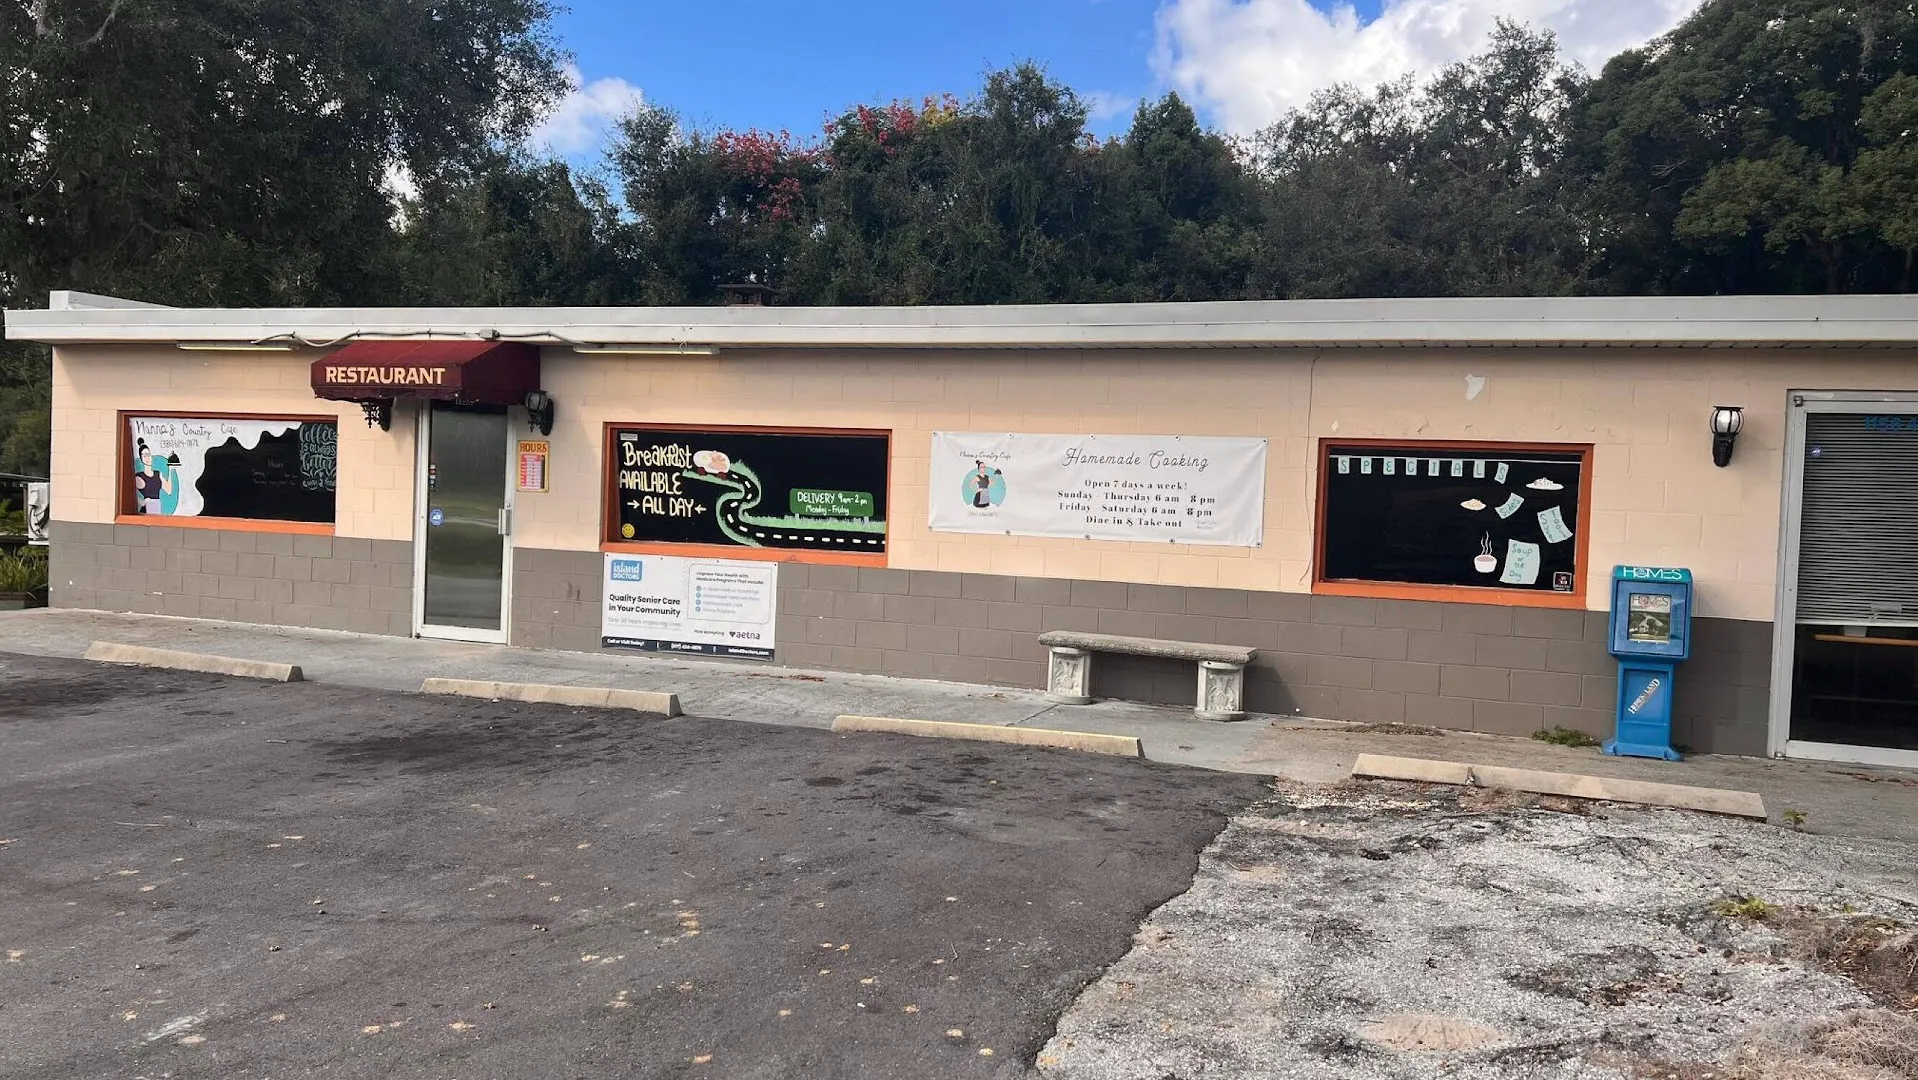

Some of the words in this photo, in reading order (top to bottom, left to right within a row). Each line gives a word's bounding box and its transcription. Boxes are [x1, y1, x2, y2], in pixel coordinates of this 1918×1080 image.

[325, 366, 446, 385] RESTAURANT
[182, 422, 213, 440] Country
[519, 442, 547, 453] HOURS
[622, 441, 693, 469] Breakfast
[1062, 447, 1141, 467] Homemade
[1149, 450, 1209, 473] Cooking
[1341, 458, 1506, 481] SPECIALS
[620, 470, 683, 495] AVAILABLE
[1084, 479, 1110, 490] Open
[1113, 480, 1120, 488] 7
[1122, 480, 1144, 491] days
[1157, 482, 1188, 491] week!
[797, 491, 836, 504] DELIVERY
[1057, 491, 1093, 500] Sunday
[1104, 492, 1151, 503] Thursday
[1155, 494, 1161, 502] 6
[1190, 494, 1197, 503] 8
[1200, 497, 1216, 505] pm
[642, 495, 666, 515] ALL
[669, 497, 695, 518] DAY
[805, 504, 827, 516] Monday
[832, 505, 850, 516] Friday
[1059, 503, 1091, 512] Friday
[1101, 504, 1148, 515] Saturday
[1151, 506, 1158, 514] 6
[1187, 507, 1194, 516] 8
[1196, 510, 1212, 518] pm
[1086, 515, 1109, 524] Dine
[1112, 516, 1123, 525] in
[1126, 519, 1134, 527] &
[1138, 518, 1162, 527] Take
[1165, 519, 1183, 528] out
[1511, 543, 1533, 558] Soup
[613, 562, 640, 574] island
[1623, 566, 1682, 580] HOMES
[609, 594, 636, 604] Quality
[637, 595, 661, 604] Senior
[662, 597, 681, 605] Care
[609, 603, 616, 611] in
[617, 604, 634, 612] Your
[635, 606, 681, 617] Community
[736, 631, 761, 640] aetna
[1643, 678, 1660, 696] LAND
